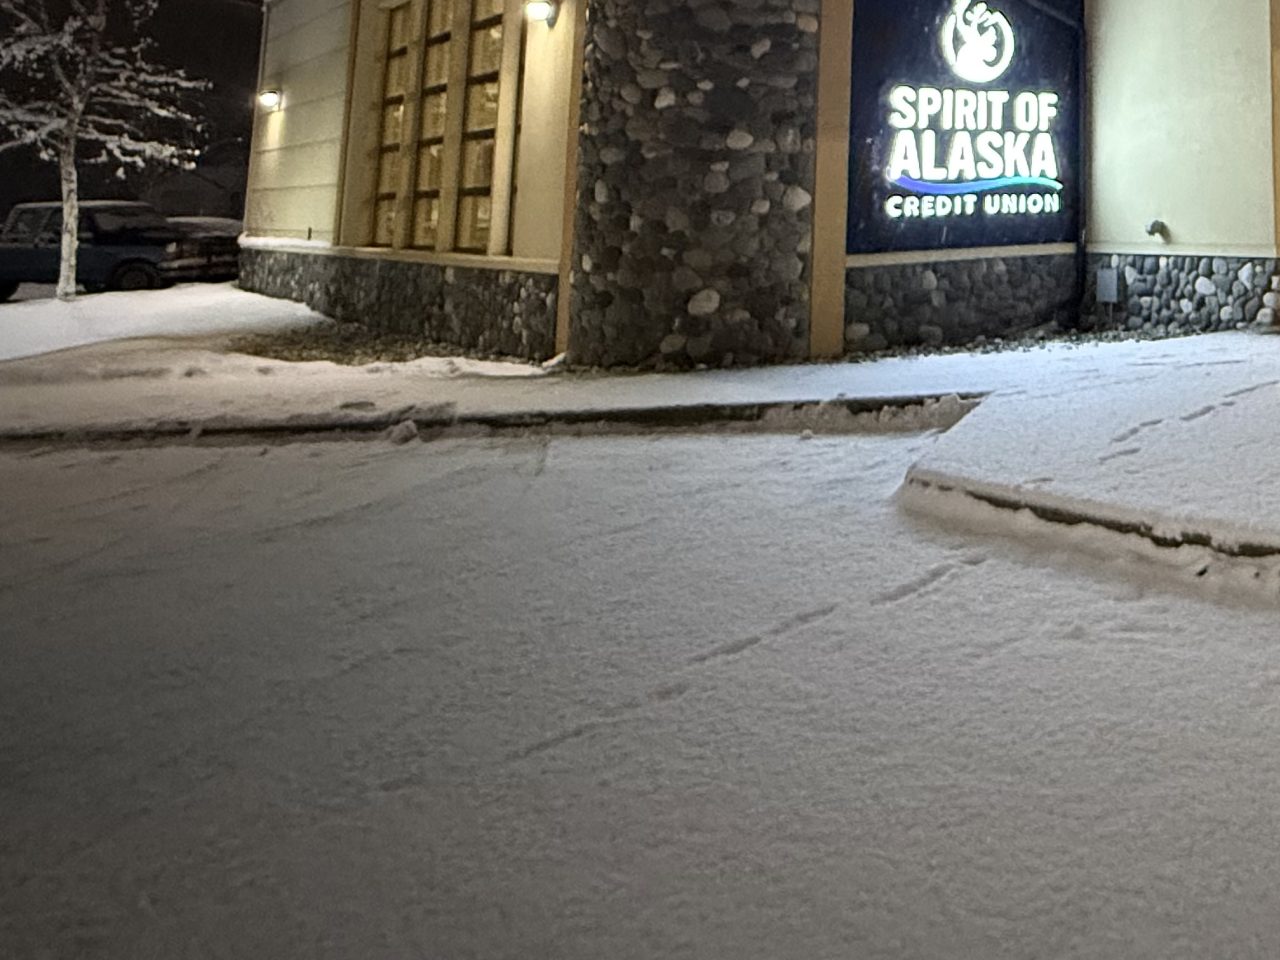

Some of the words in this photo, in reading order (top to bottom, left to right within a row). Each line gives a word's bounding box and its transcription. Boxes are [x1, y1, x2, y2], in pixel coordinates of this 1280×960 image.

[889, 85, 1009, 130] SPIRIT
[1014, 91, 1059, 131] OF
[889, 129, 1058, 180] ALASKA
[886, 195, 978, 218] CREDIT
[984, 193, 1060, 215] UNION
